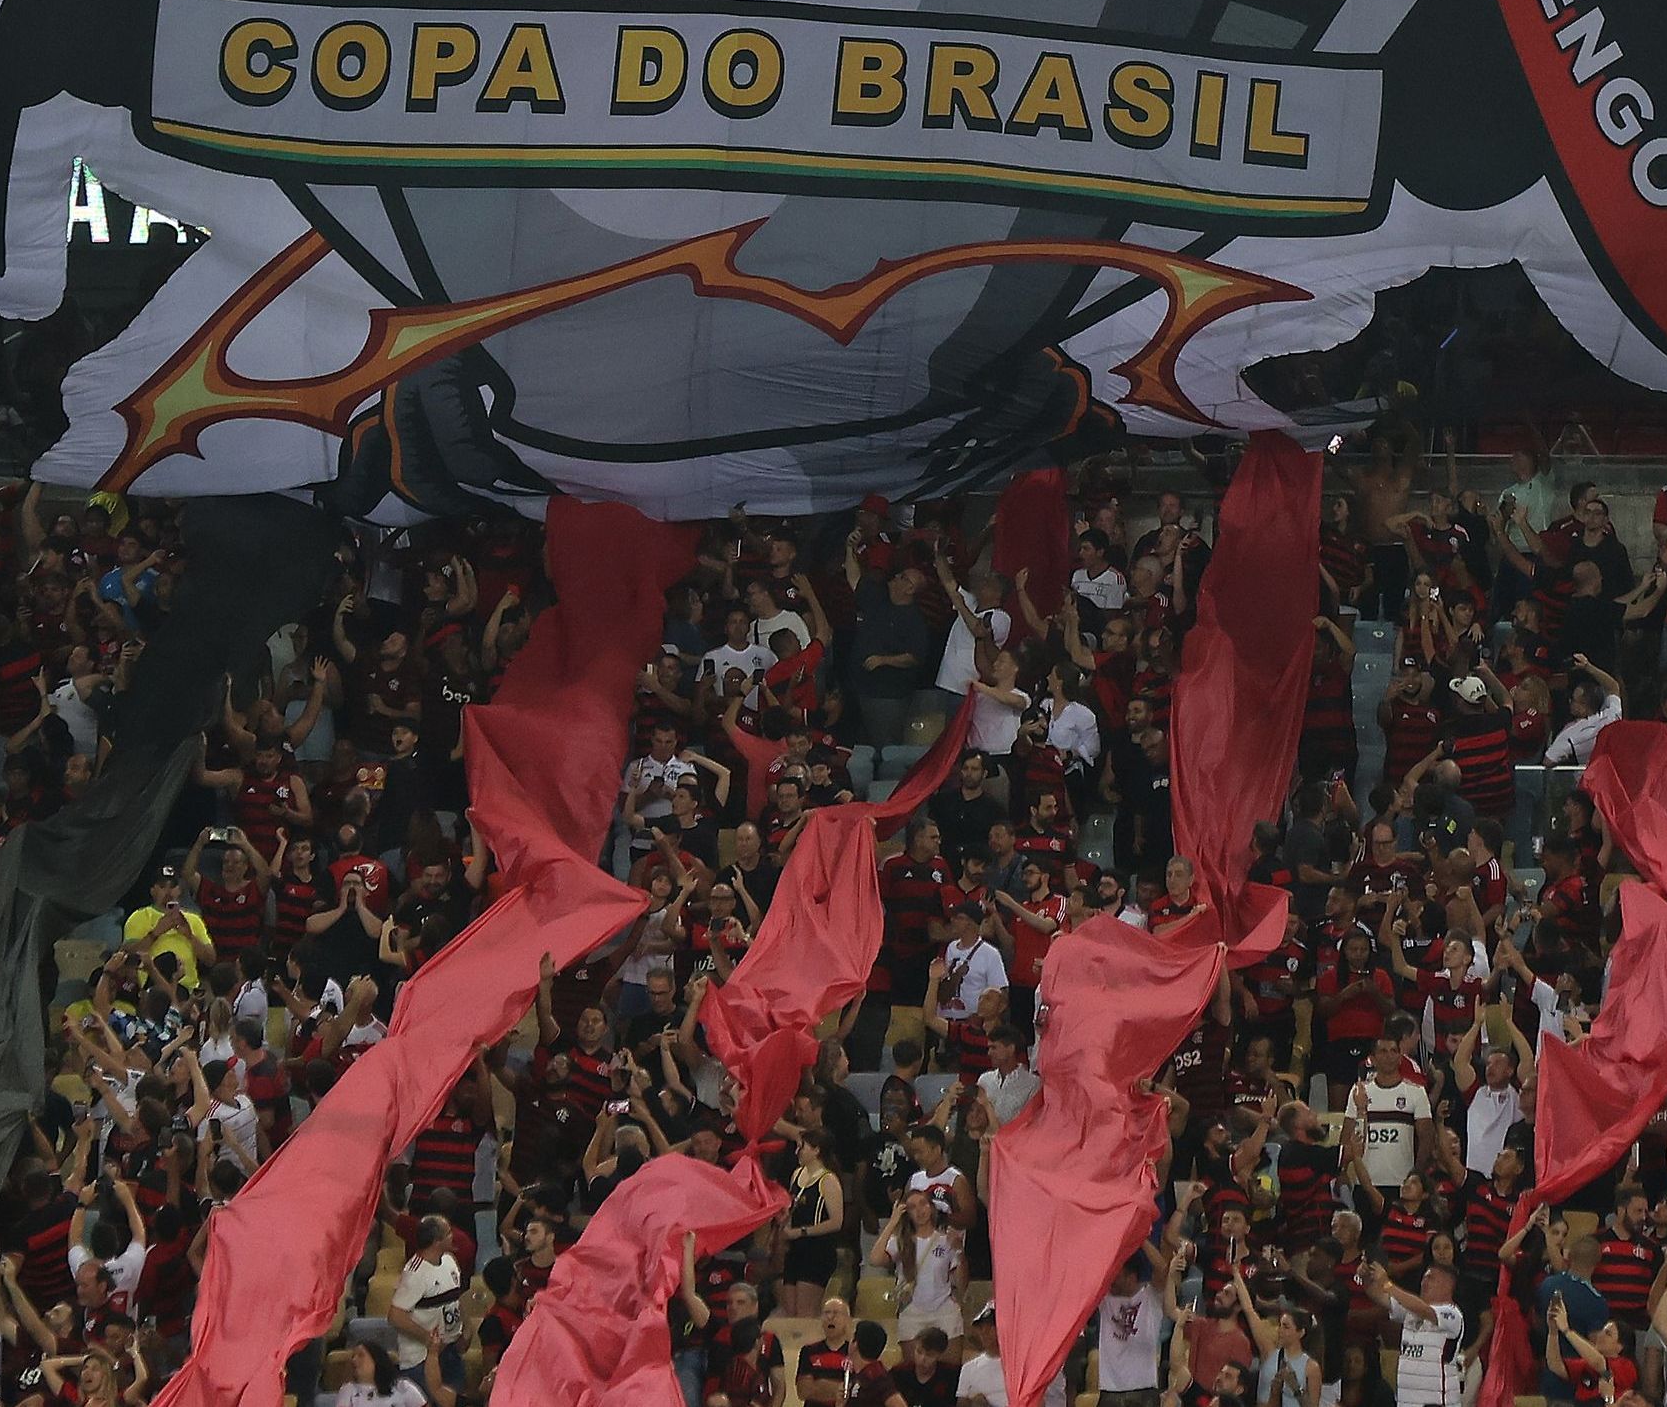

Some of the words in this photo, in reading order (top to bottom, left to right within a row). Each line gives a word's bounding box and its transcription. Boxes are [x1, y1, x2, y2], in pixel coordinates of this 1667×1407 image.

[218, 17, 567, 115] COPA
[609, 23, 785, 122] DO
[831, 35, 1312, 169] BRASIL
